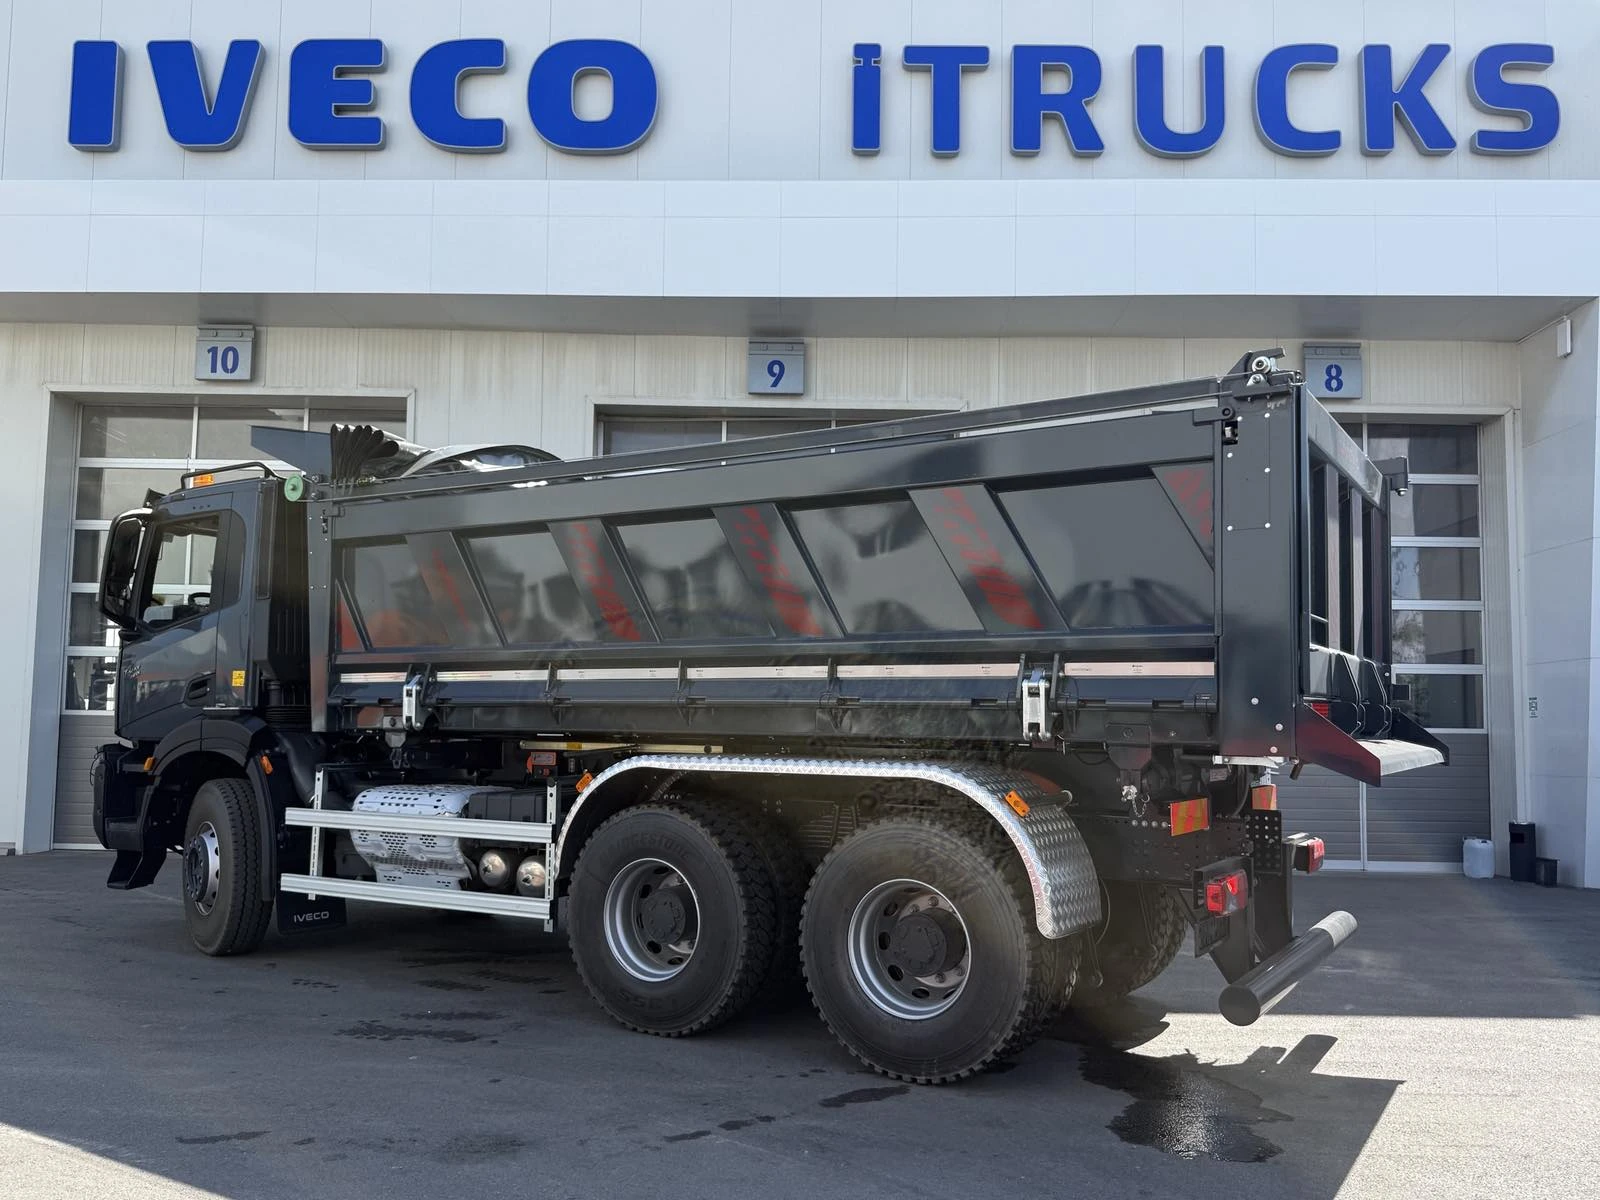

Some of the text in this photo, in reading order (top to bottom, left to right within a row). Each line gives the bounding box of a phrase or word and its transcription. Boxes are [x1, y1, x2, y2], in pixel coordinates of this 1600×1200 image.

[68, 38, 659, 154] IVECO
[207, 346, 239, 373] 10
[767, 359, 785, 387] 9
[1324, 364, 1343, 392] 8
[293, 911, 330, 923] IVECO
